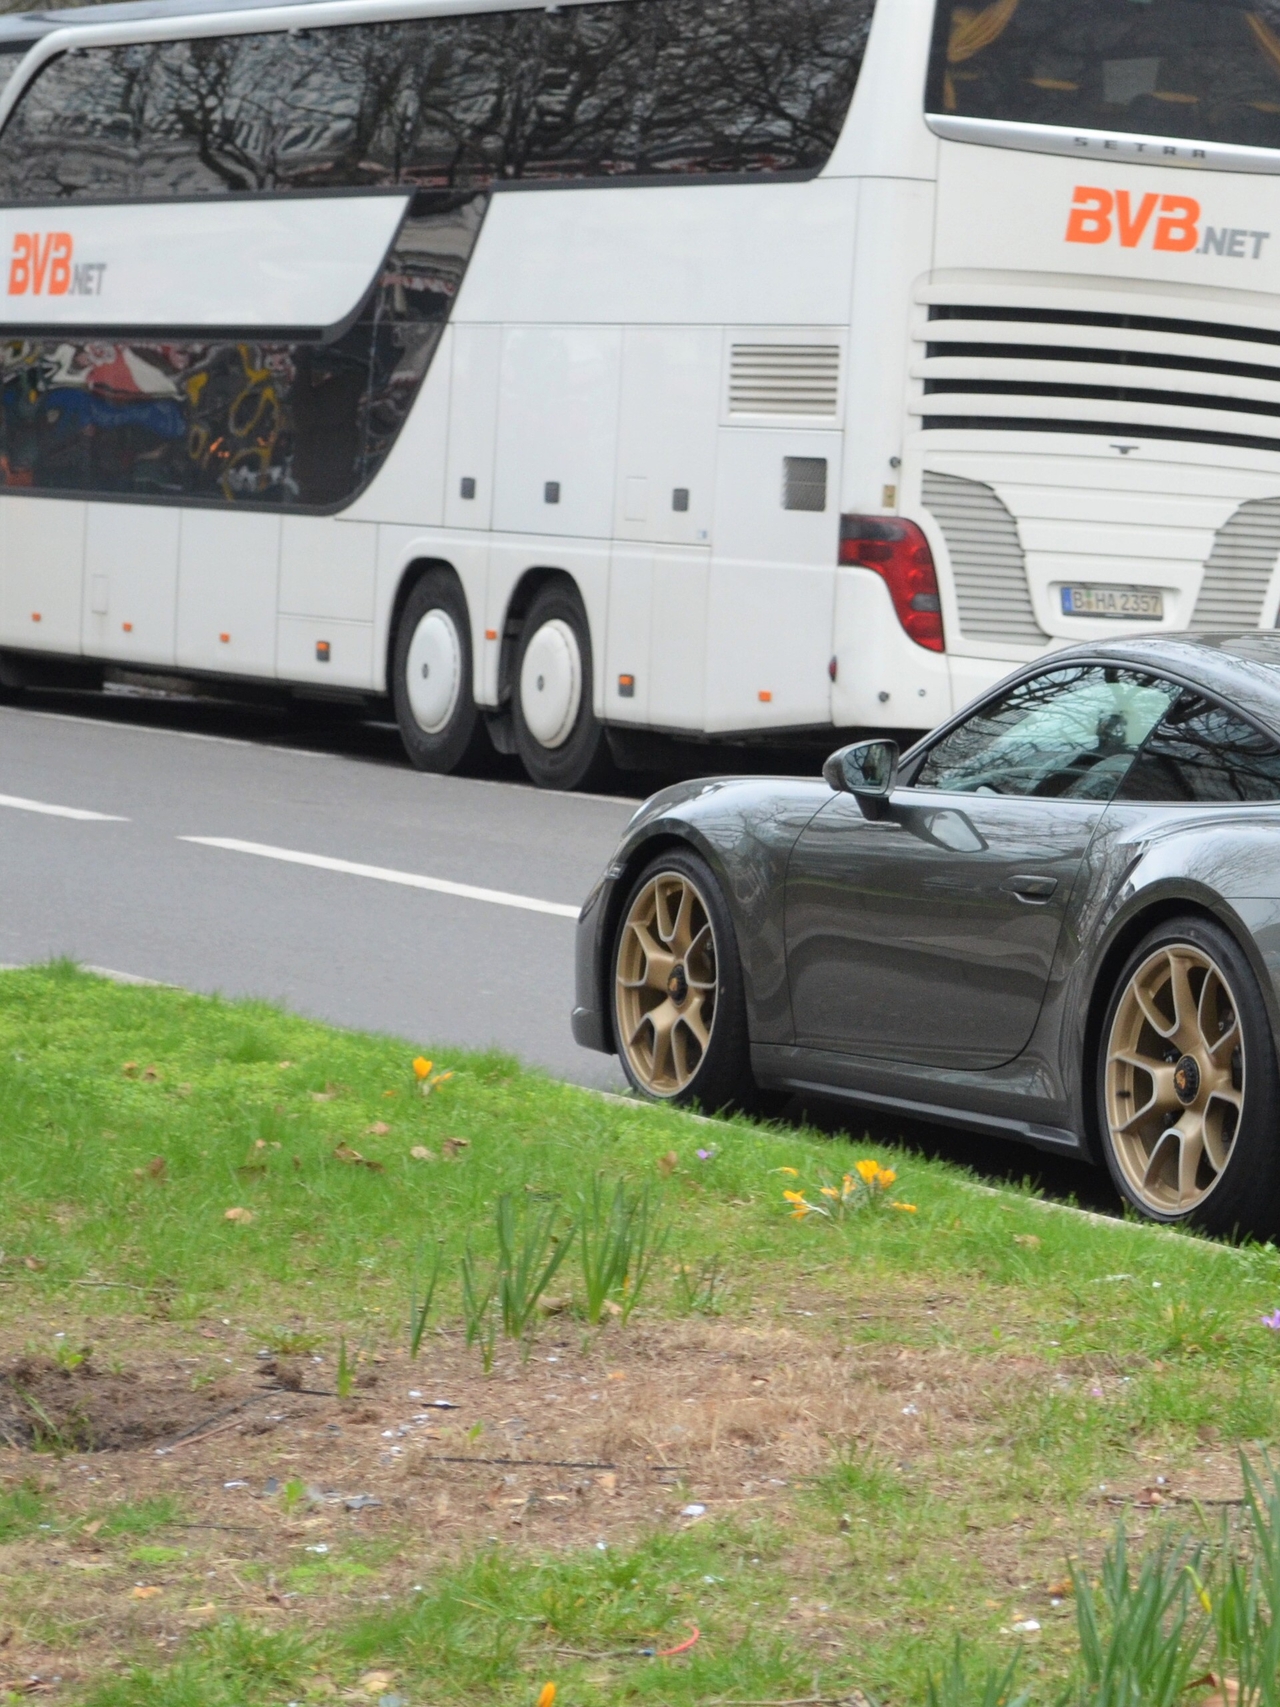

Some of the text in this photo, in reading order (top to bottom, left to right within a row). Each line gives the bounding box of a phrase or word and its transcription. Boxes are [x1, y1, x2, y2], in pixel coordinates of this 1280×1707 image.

[1073, 137, 1206, 158] SETRA
[1073, 591, 1160, 612] B HA 2357
